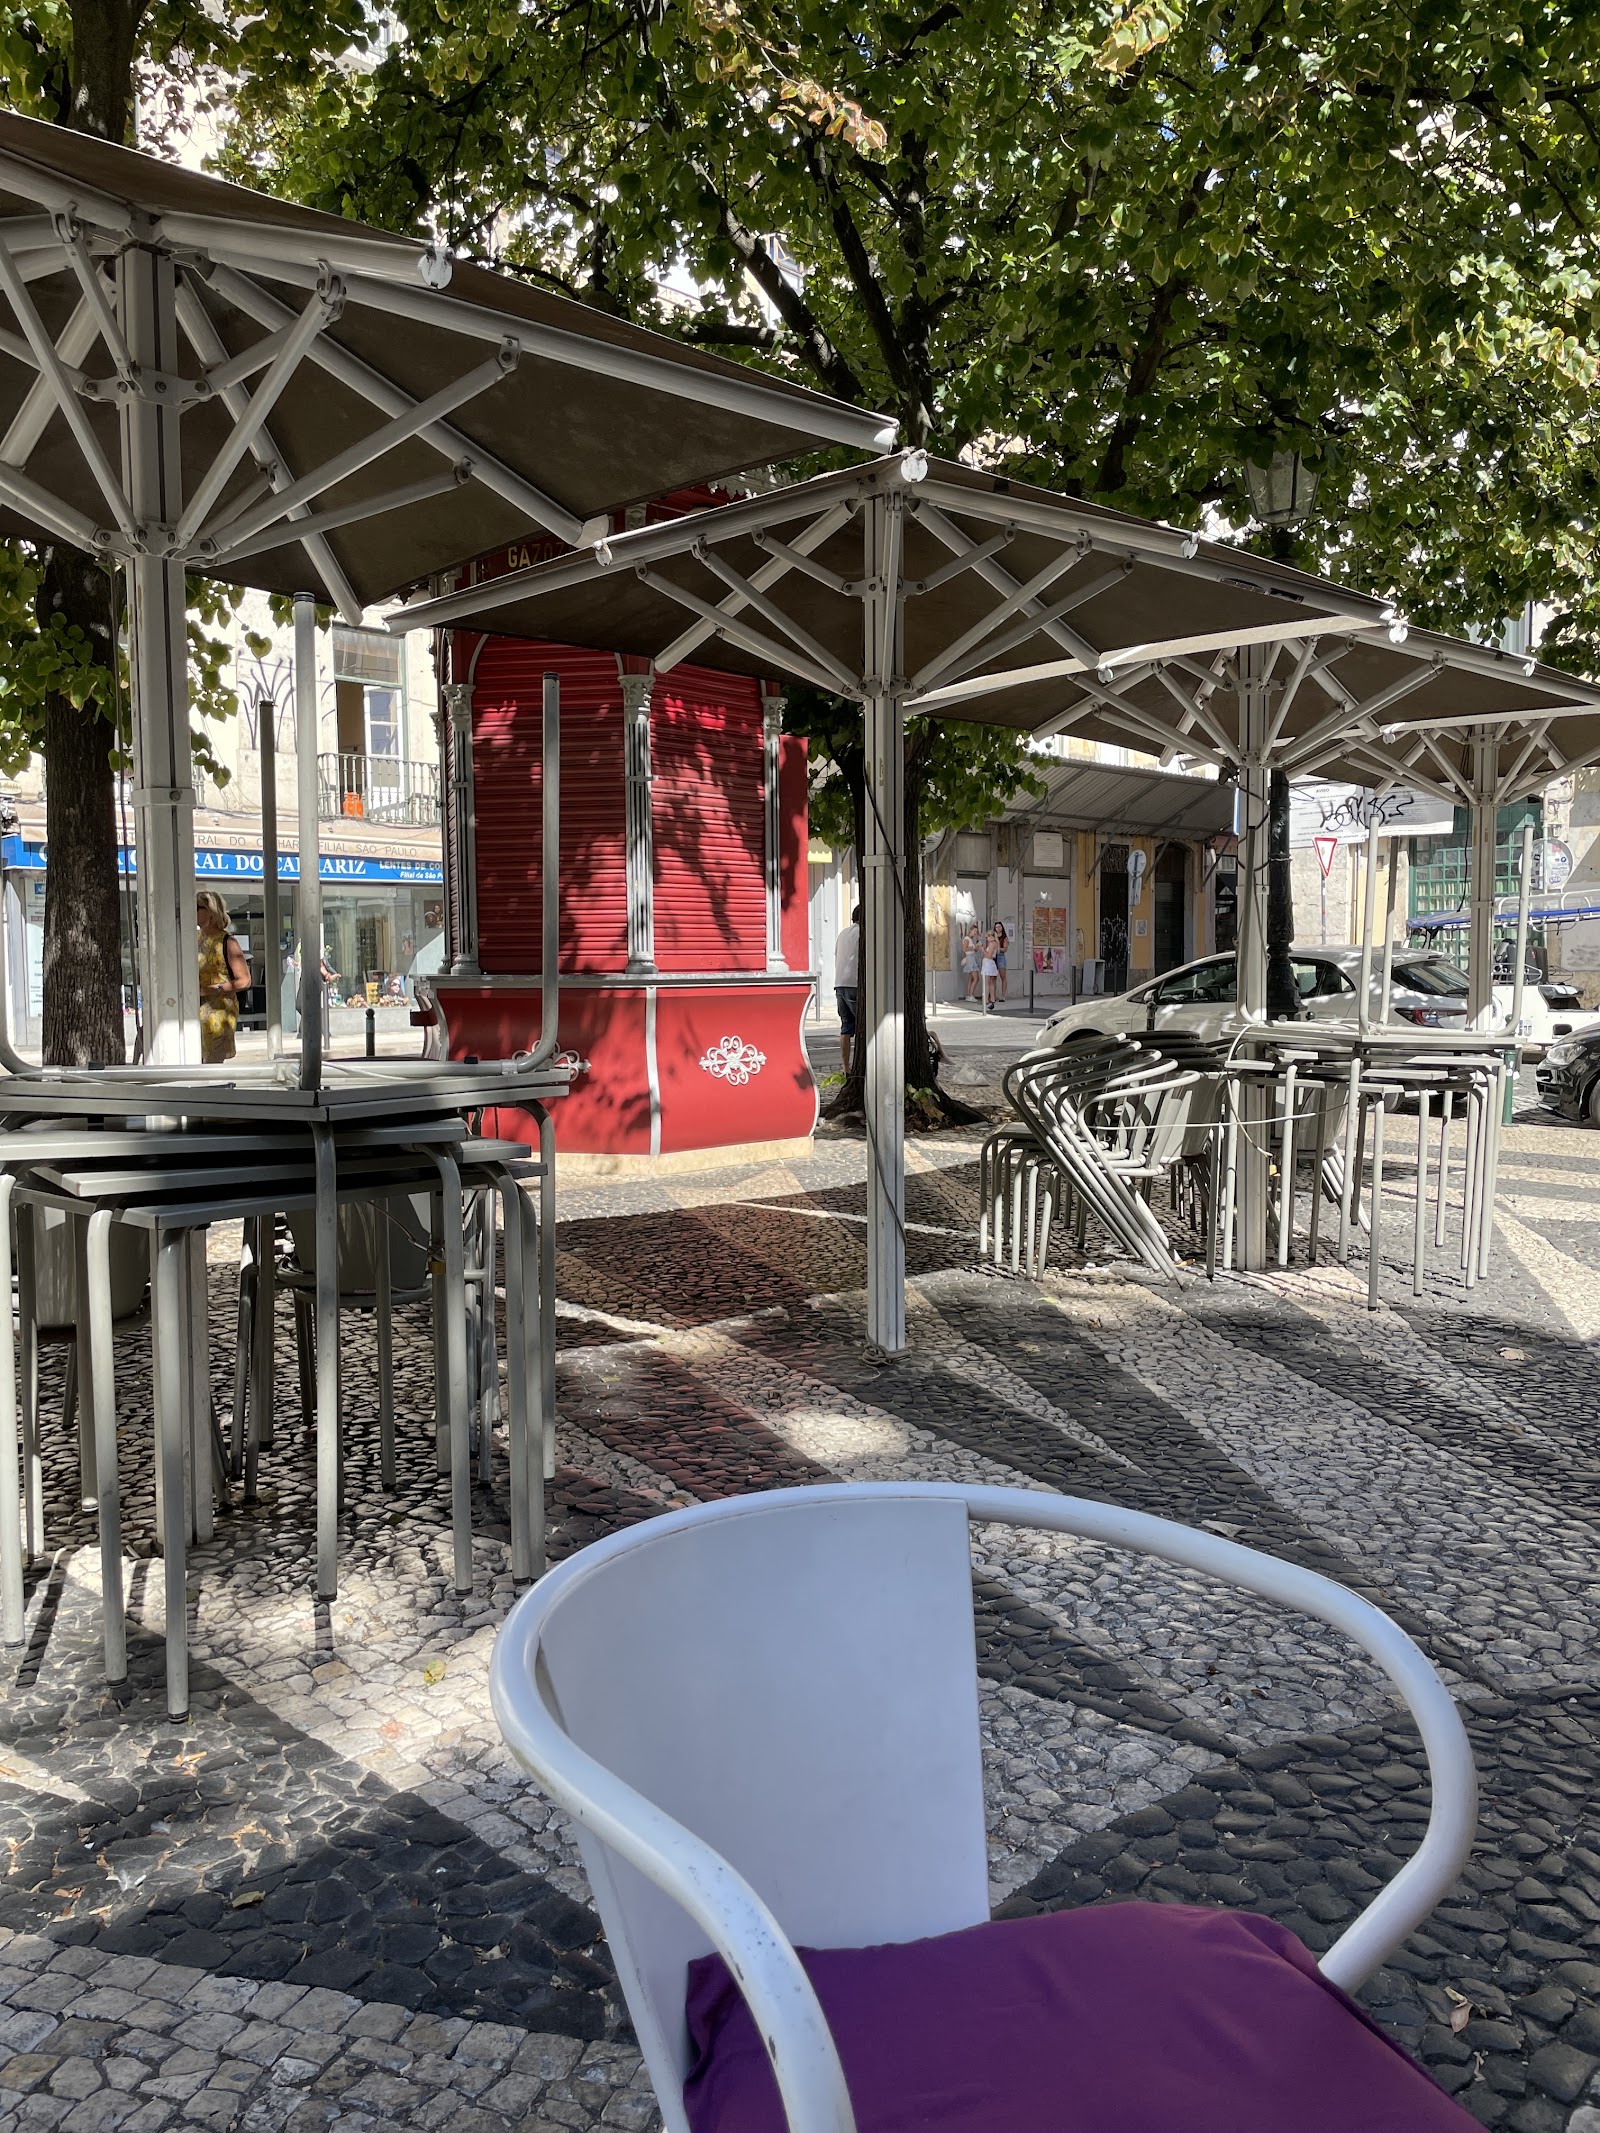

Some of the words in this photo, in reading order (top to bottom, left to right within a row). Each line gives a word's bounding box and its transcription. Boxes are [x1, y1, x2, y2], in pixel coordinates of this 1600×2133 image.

[229, 836, 246, 847] DO
[385, 845, 417, 858] PAULO
[235, 854, 264, 872] DO
[379, 860, 411, 870] LENTES
[414, 862, 426, 871] DE
